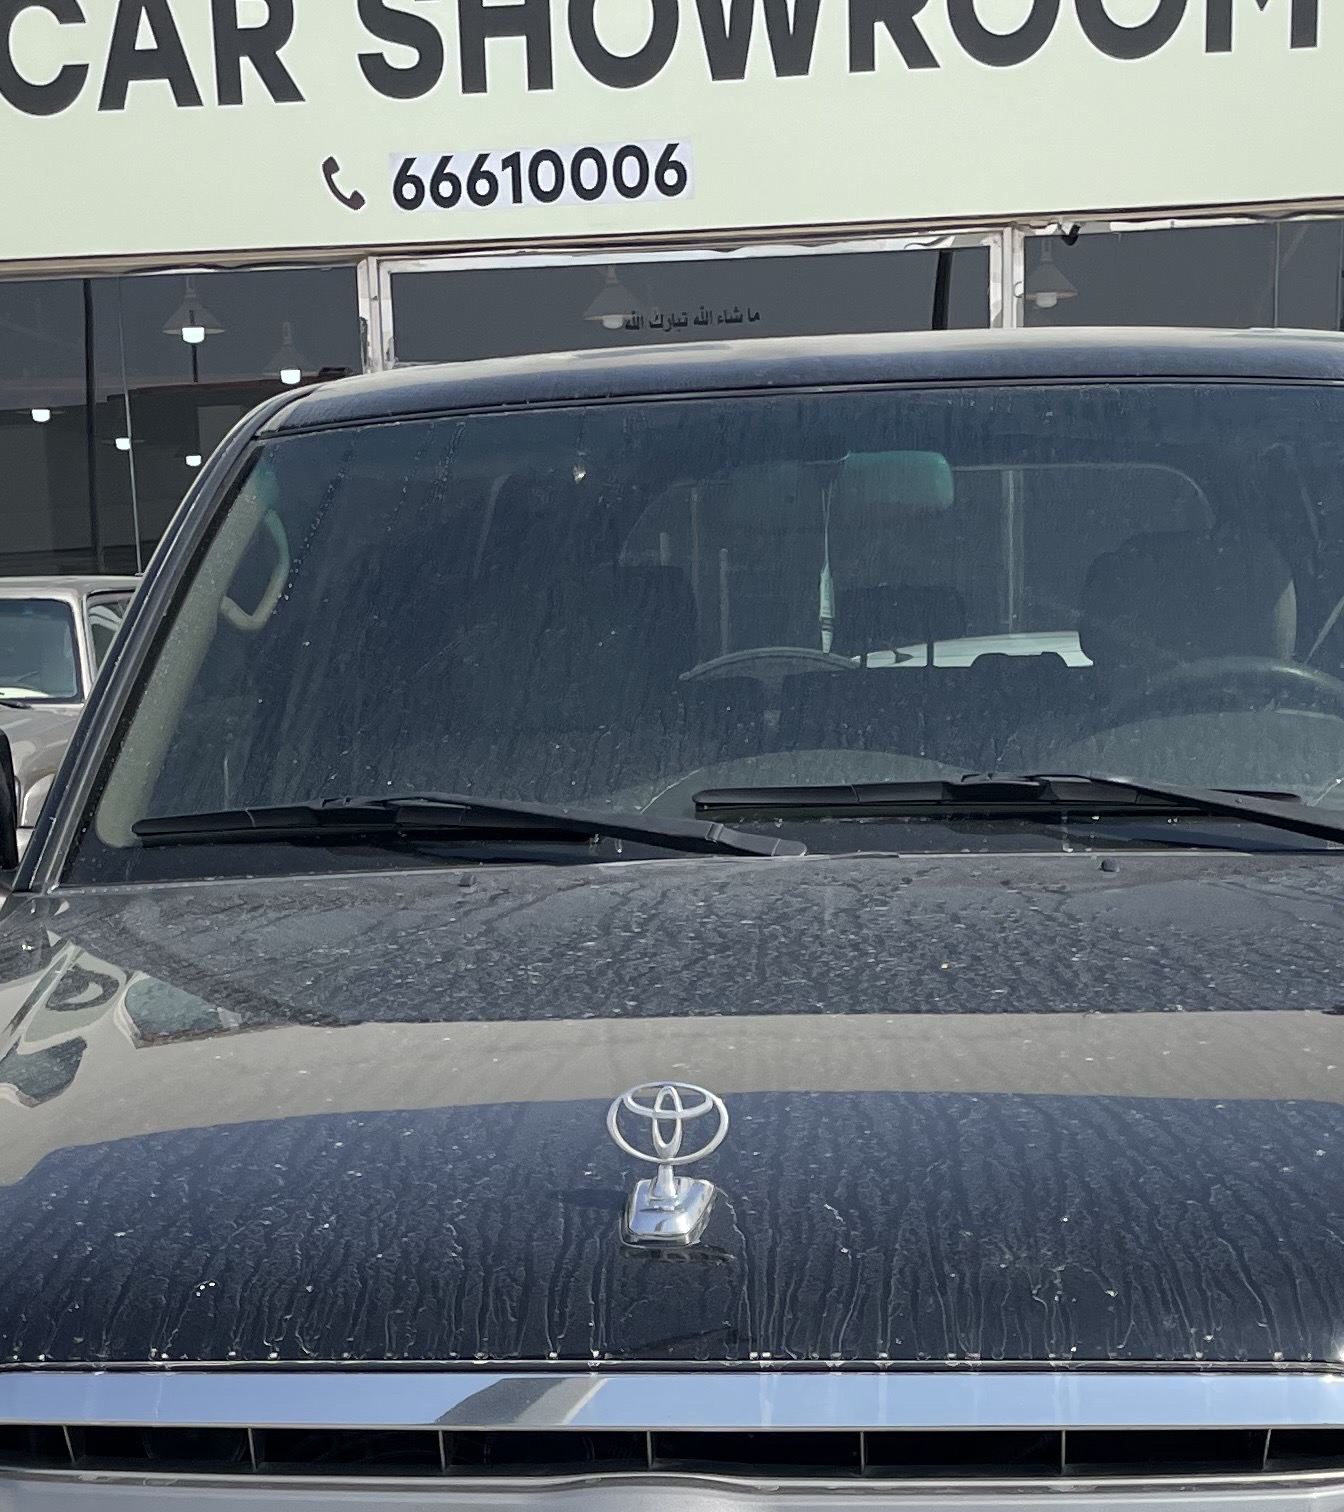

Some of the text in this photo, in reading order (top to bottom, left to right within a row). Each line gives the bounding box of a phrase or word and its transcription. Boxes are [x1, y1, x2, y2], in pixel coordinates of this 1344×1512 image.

[391, 141, 688, 212] 66610006
[625, 306, 761, 333] ما شاء الله تبارك الله
